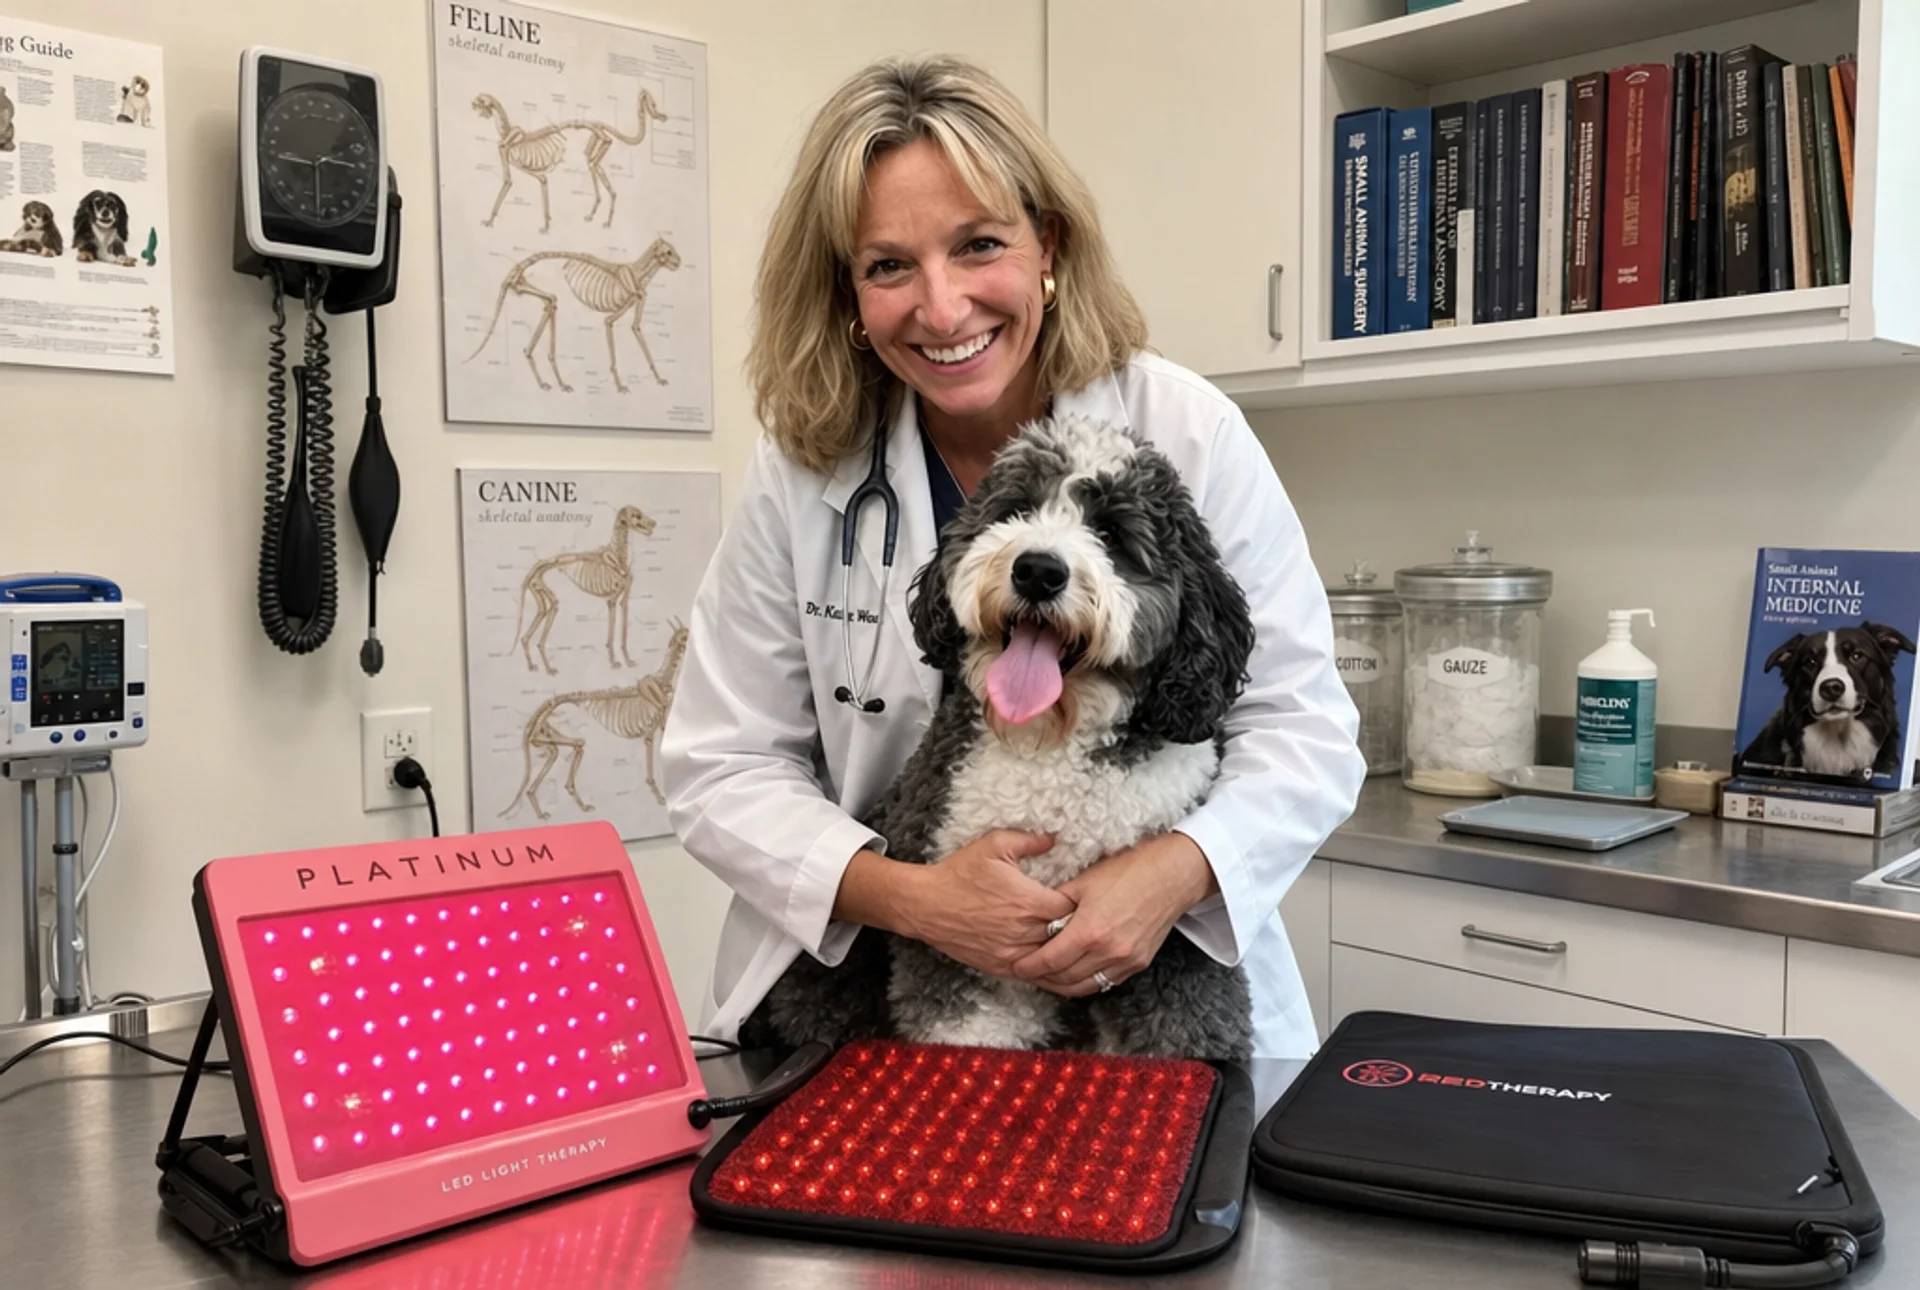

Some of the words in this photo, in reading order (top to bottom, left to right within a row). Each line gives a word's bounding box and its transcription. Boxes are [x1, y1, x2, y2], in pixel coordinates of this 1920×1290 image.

[449, 4, 542, 45] FELINE
[20, 35, 74, 59] Guide
[448, 34, 503, 57] skeletal
[507, 50, 566, 74] anatomy
[1354, 155, 1369, 204] SMALL
[478, 480, 577, 503] CANINE
[478, 507, 532, 523] skeletal
[536, 510, 593, 528] anatomy
[1767, 577, 1865, 596] INTERNAL
[806, 601, 822, 617] Dr.
[1765, 596, 1862, 616] MEDICINE
[1336, 657, 1377, 671] COTTON
[1443, 658, 1488, 675] GAUZE
[296, 844, 555, 889] PLATINUM
[441, 1174, 474, 1192] LED
[482, 1159, 530, 1181] LIGHT
[538, 1137, 607, 1165] THERAPY
